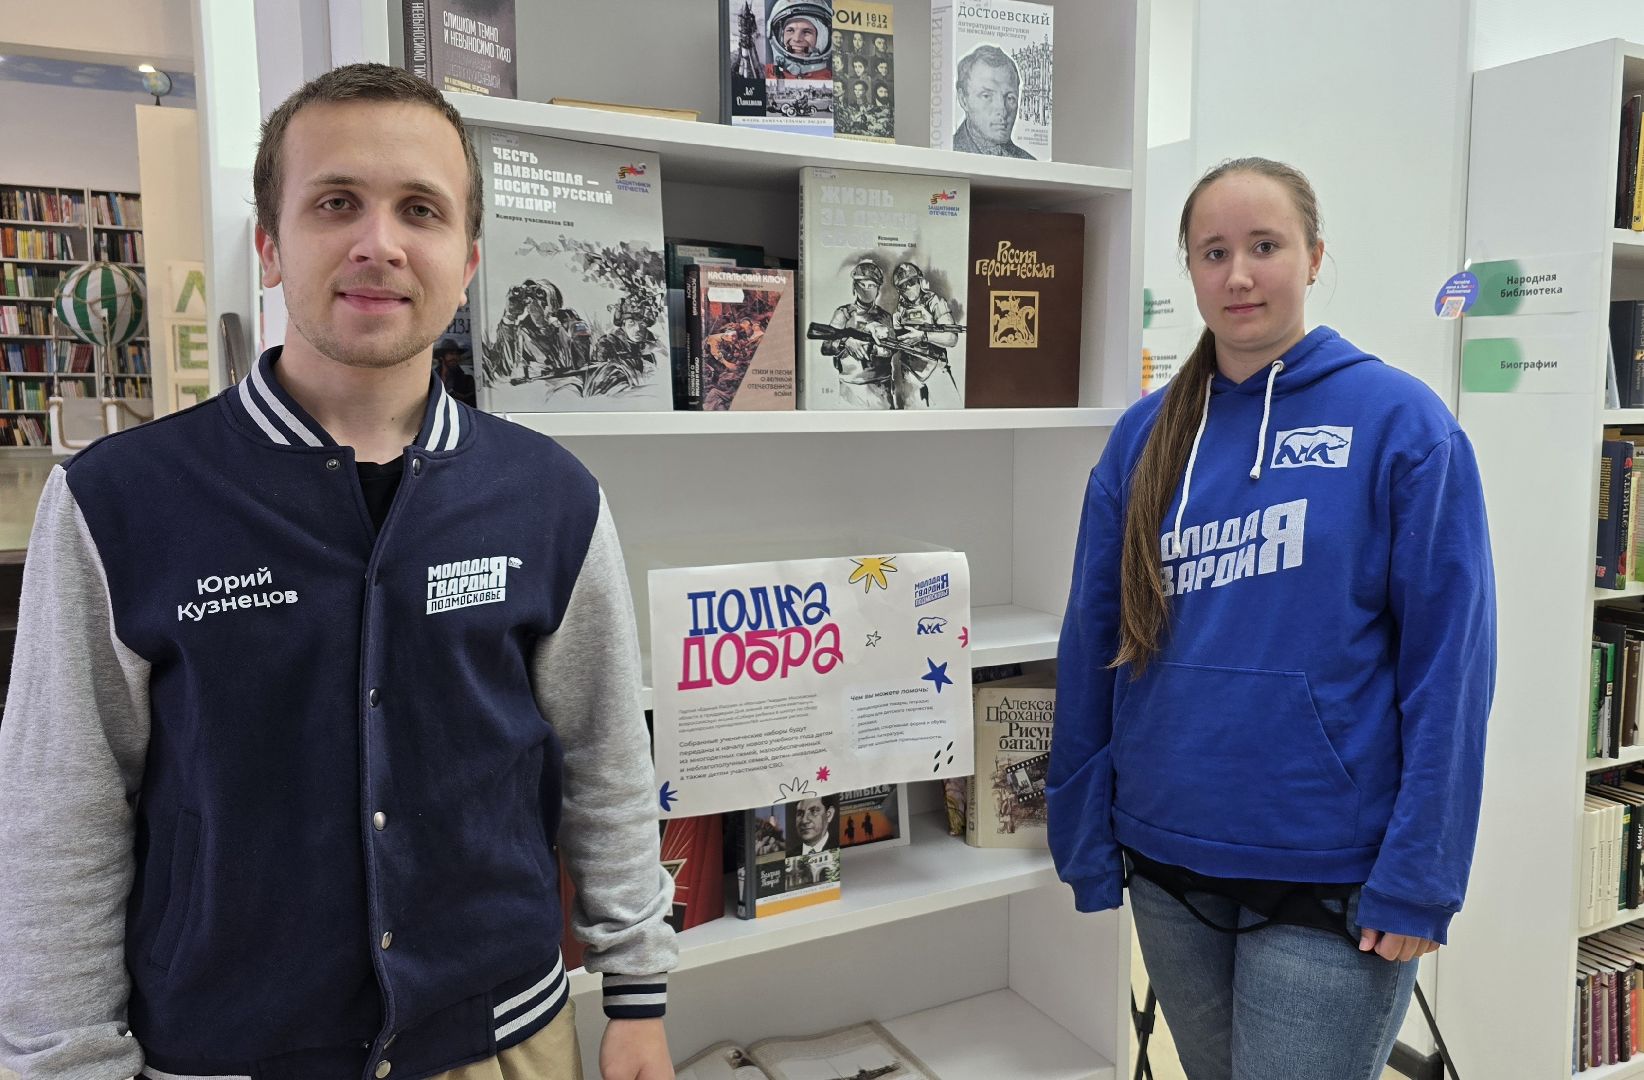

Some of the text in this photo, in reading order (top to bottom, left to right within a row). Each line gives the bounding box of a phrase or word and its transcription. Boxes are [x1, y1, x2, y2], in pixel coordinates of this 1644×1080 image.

[443, 10, 499, 43] СЛИШКОМ ТЕМНО
[866, 12, 888, 24] 1812
[411, 2, 427, 80] НЕВЫНОСИМО ТИХ
[443, 27, 512, 64] И НЕВЫНОСИМО ТИХО
[492, 146, 539, 165] ЧЕСТЬ
[493, 162, 584, 187] НАИВЫСШАЯ
[493, 178, 614, 205] НОСИТЬ РУССКИЙ
[616, 184, 649, 194] ОТЕЧЕСТВА
[820, 185, 894, 208] ЖИЗНЬ
[494, 193, 557, 213] МУНДИР!
[928, 204, 960, 212] ЗАЩИТНИКИ
[563, 219, 575, 227] СВО
[996, 240, 1037, 264] Россия
[707, 271, 786, 284] КАСТАЛЬСКИЙ КЛЮЧ
[1506, 273, 1557, 287] Народная
[1500, 285, 1563, 298] библиотека
[1500, 359, 1558, 371] Биографии
[1621, 472, 1631, 528] ЭТИКЕТА
[1160, 499, 1307, 564] ОЛОДАЯ
[1159, 530, 1307, 597] ВАРДИЯ
[196, 566, 273, 595] Юрий
[177, 590, 299, 622] Кузнецов
[431, 590, 501, 612] ПОДМОСКОВЬЕ
[850, 694, 863, 702] Чем
[874, 689, 900, 698] можете
[900, 686, 930, 695] помочь:
[1000, 696, 1055, 712] Алекса
[985, 706, 1055, 723] Прохано
[679, 726, 807, 749] Собранные ученические наборы будут
[679, 747, 715, 757] переданы
[721, 742, 745, 751] началу
[745, 739, 768, 748] нового
[769, 735, 799, 746] учебного
[799, 732, 814, 740] года
[999, 735, 1051, 751] батали
[689, 753, 735, 763] многодетных
[759, 740, 821, 754] малообеспеченных
[686, 759, 747, 772] неблагополучных
[729, 764, 768, 776] участников
